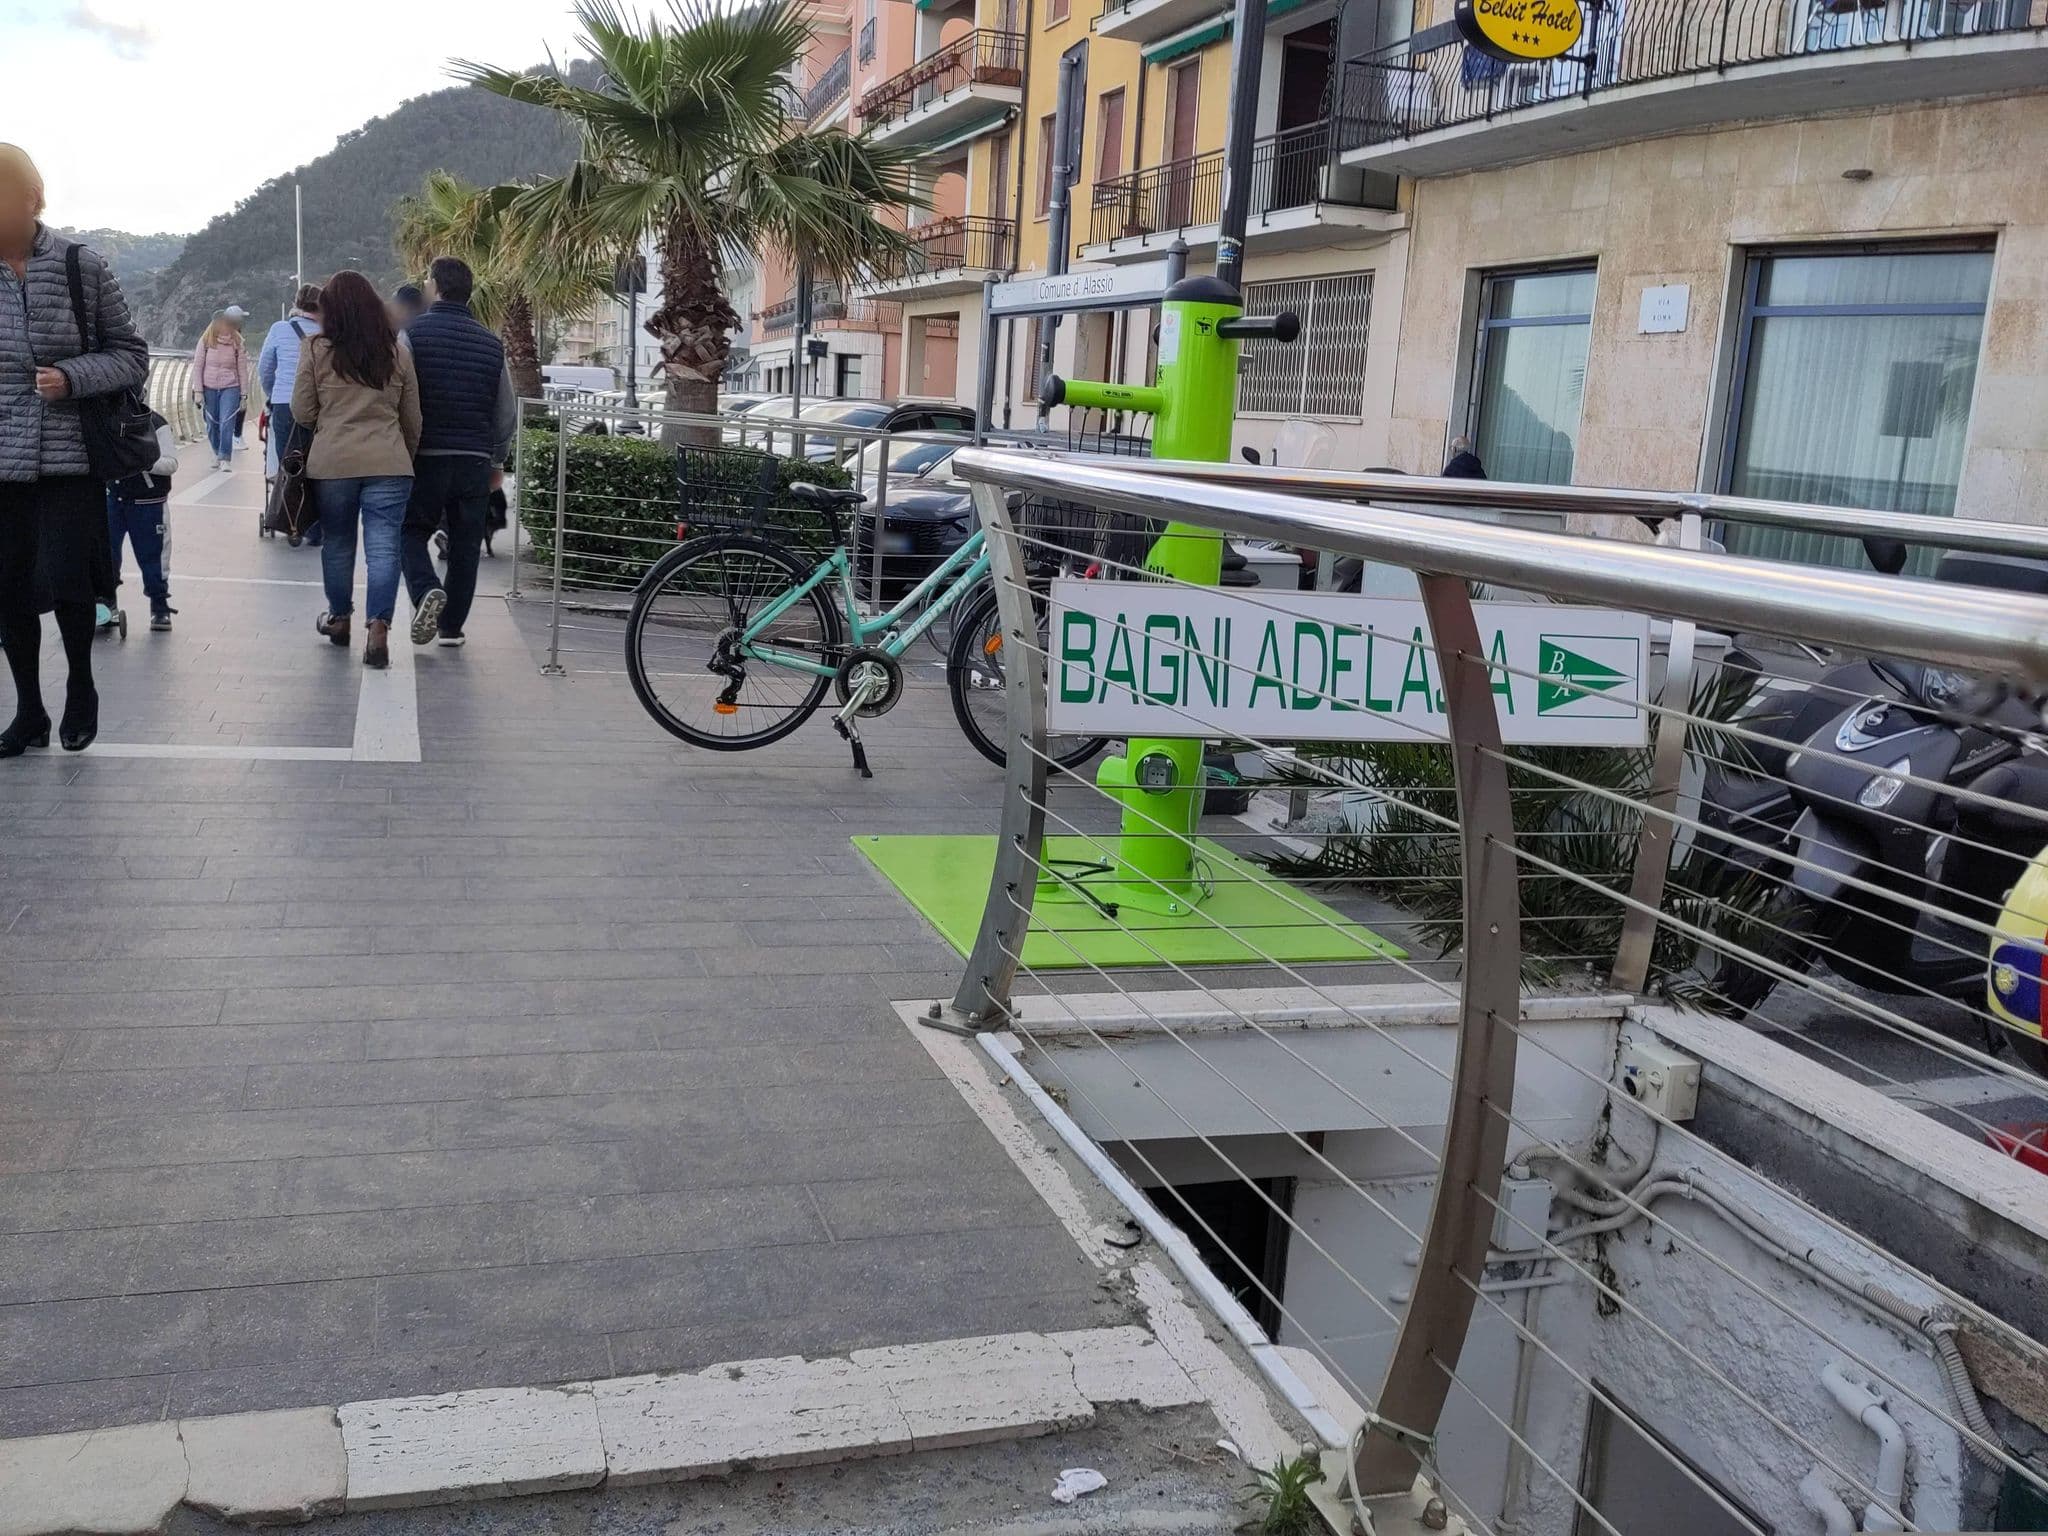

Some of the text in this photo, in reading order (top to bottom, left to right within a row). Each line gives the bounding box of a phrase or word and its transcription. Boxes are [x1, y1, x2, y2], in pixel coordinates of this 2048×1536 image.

[1478, 0, 1577, 32] Belsit Hotel
[1039, 278, 1072, 300] Comune
[1083, 273, 1114, 296] Alassio
[902, 575, 971, 647] Bianchi
[1060, 610, 1515, 716] BAGNI ADELAA
[1548, 650, 1566, 674] B
